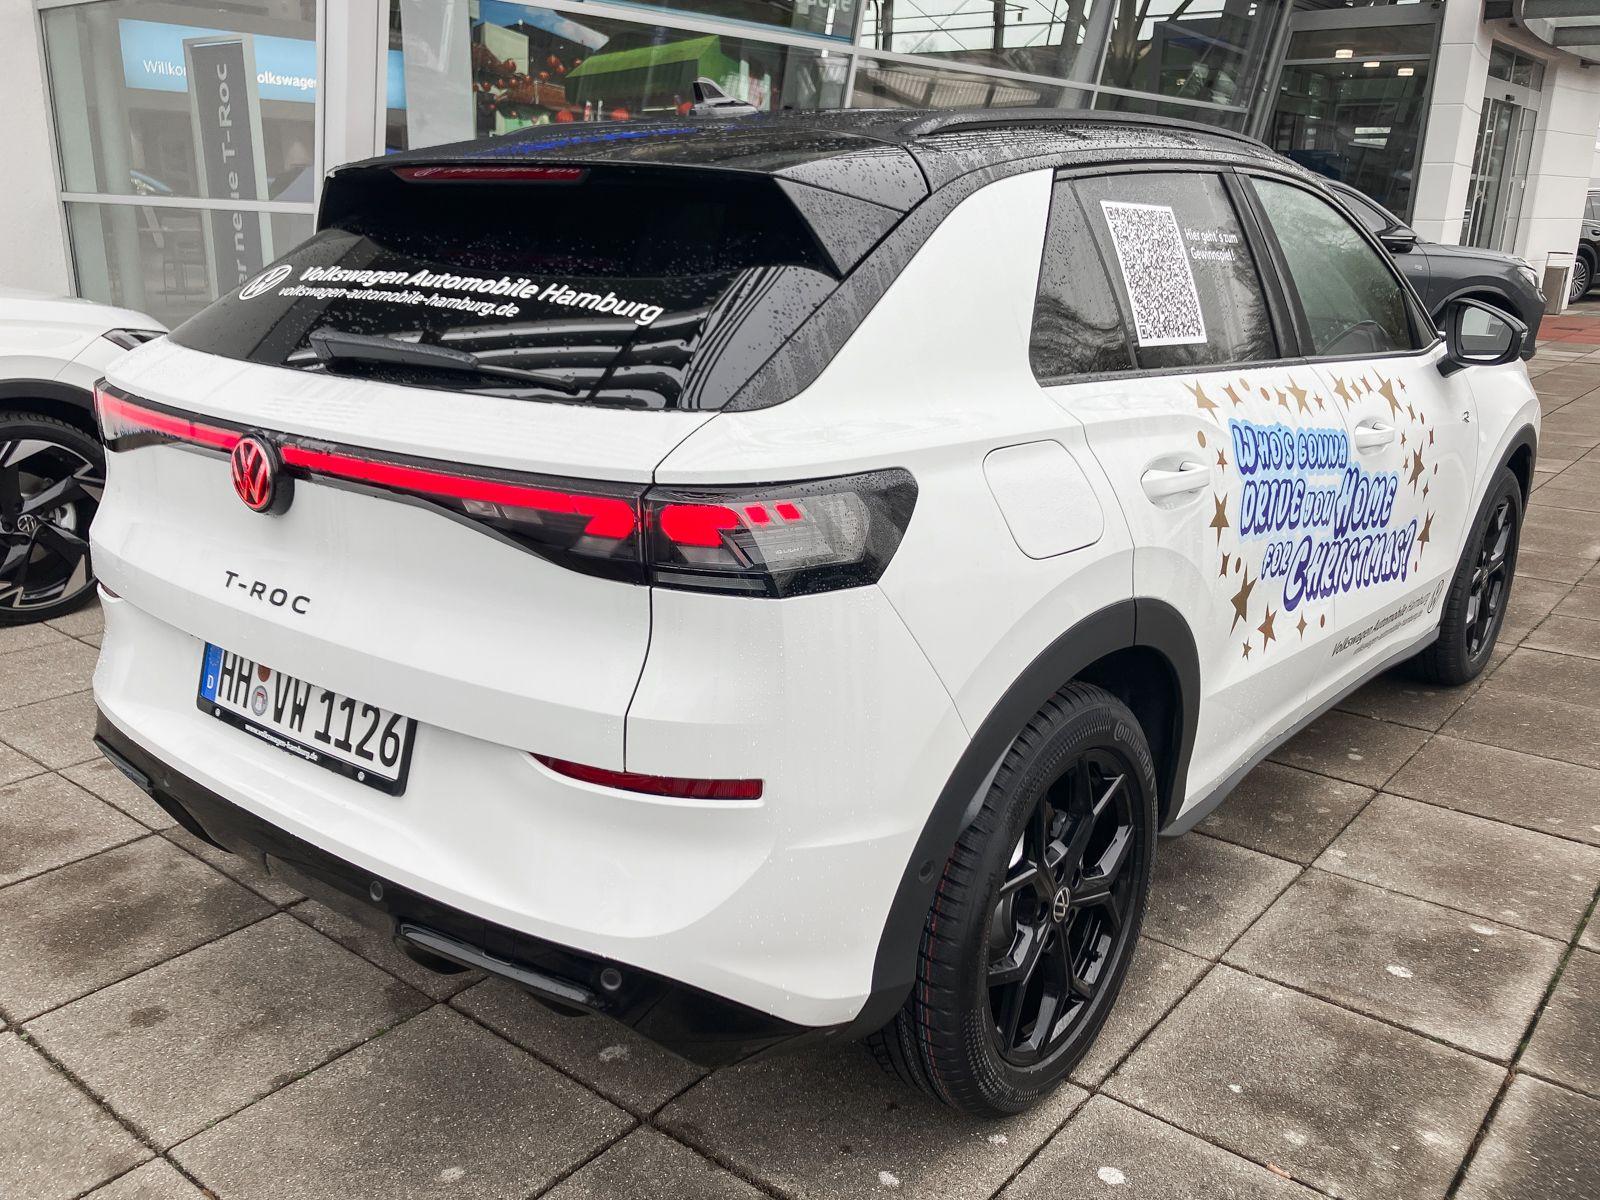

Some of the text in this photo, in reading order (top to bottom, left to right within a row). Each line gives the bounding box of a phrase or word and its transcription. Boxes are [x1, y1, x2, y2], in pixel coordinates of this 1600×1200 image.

[256, 70, 317, 91] olkswage
[278, 284, 520, 318] volkswagen-automobile-hamburg.de
[299, 265, 665, 326] Volkswagen Automobile Hamburg
[223, 569, 312, 615] T-ROC
[218, 649, 401, 768] HH VW 1126
